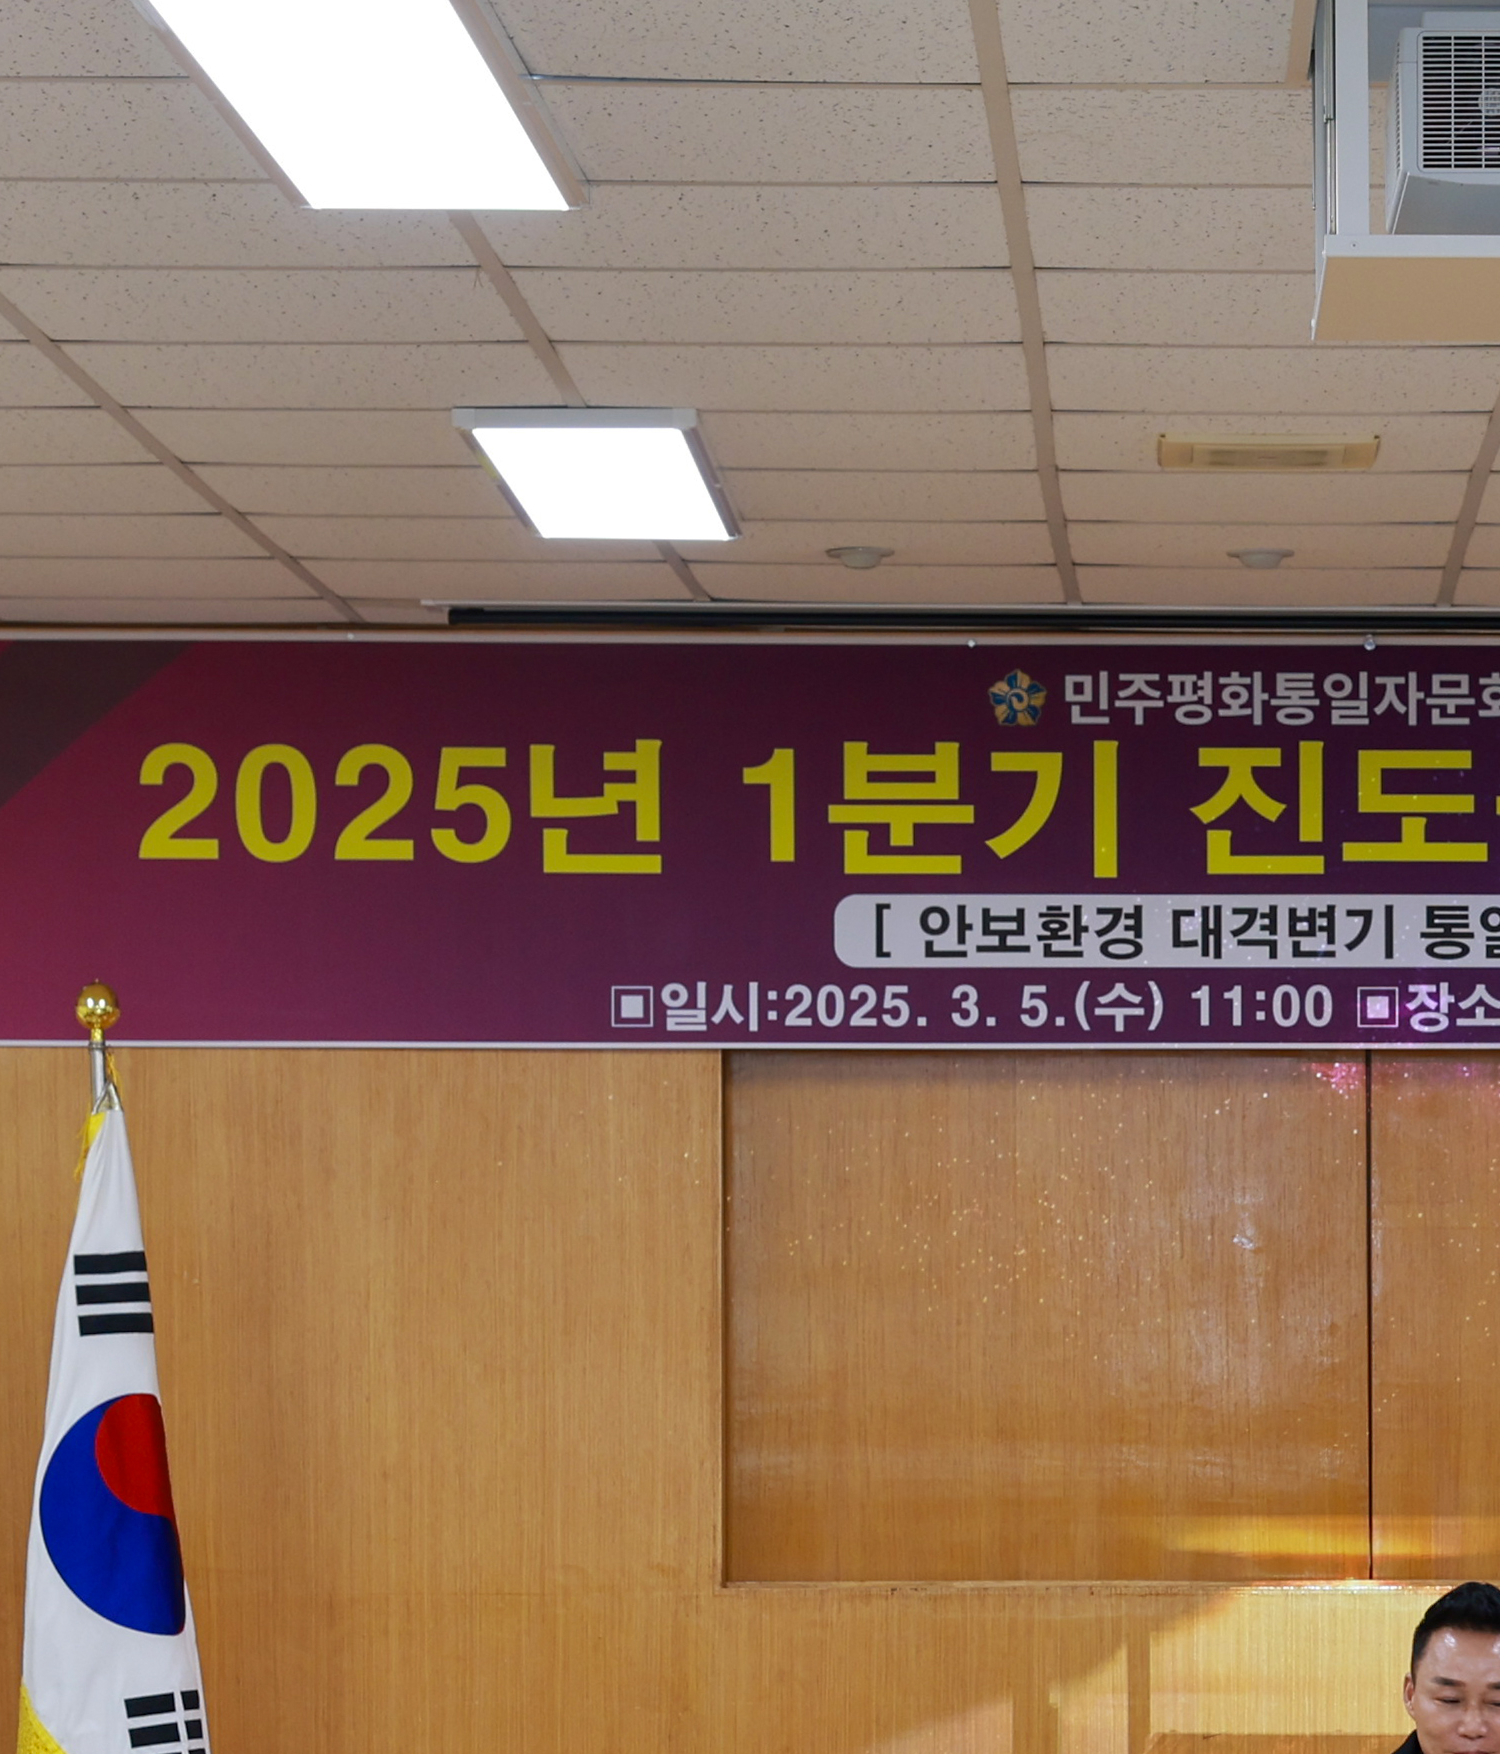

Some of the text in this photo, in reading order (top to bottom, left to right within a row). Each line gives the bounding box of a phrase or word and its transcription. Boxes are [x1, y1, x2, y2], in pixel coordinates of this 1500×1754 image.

[139, 740, 661, 873] 2025년
[744, 742, 1118, 877] 1분기
[920, 905, 1142, 959] 안보환경
[1173, 905, 1393, 959] 대격변기
[1192, 985, 1332, 1026] 11:00
